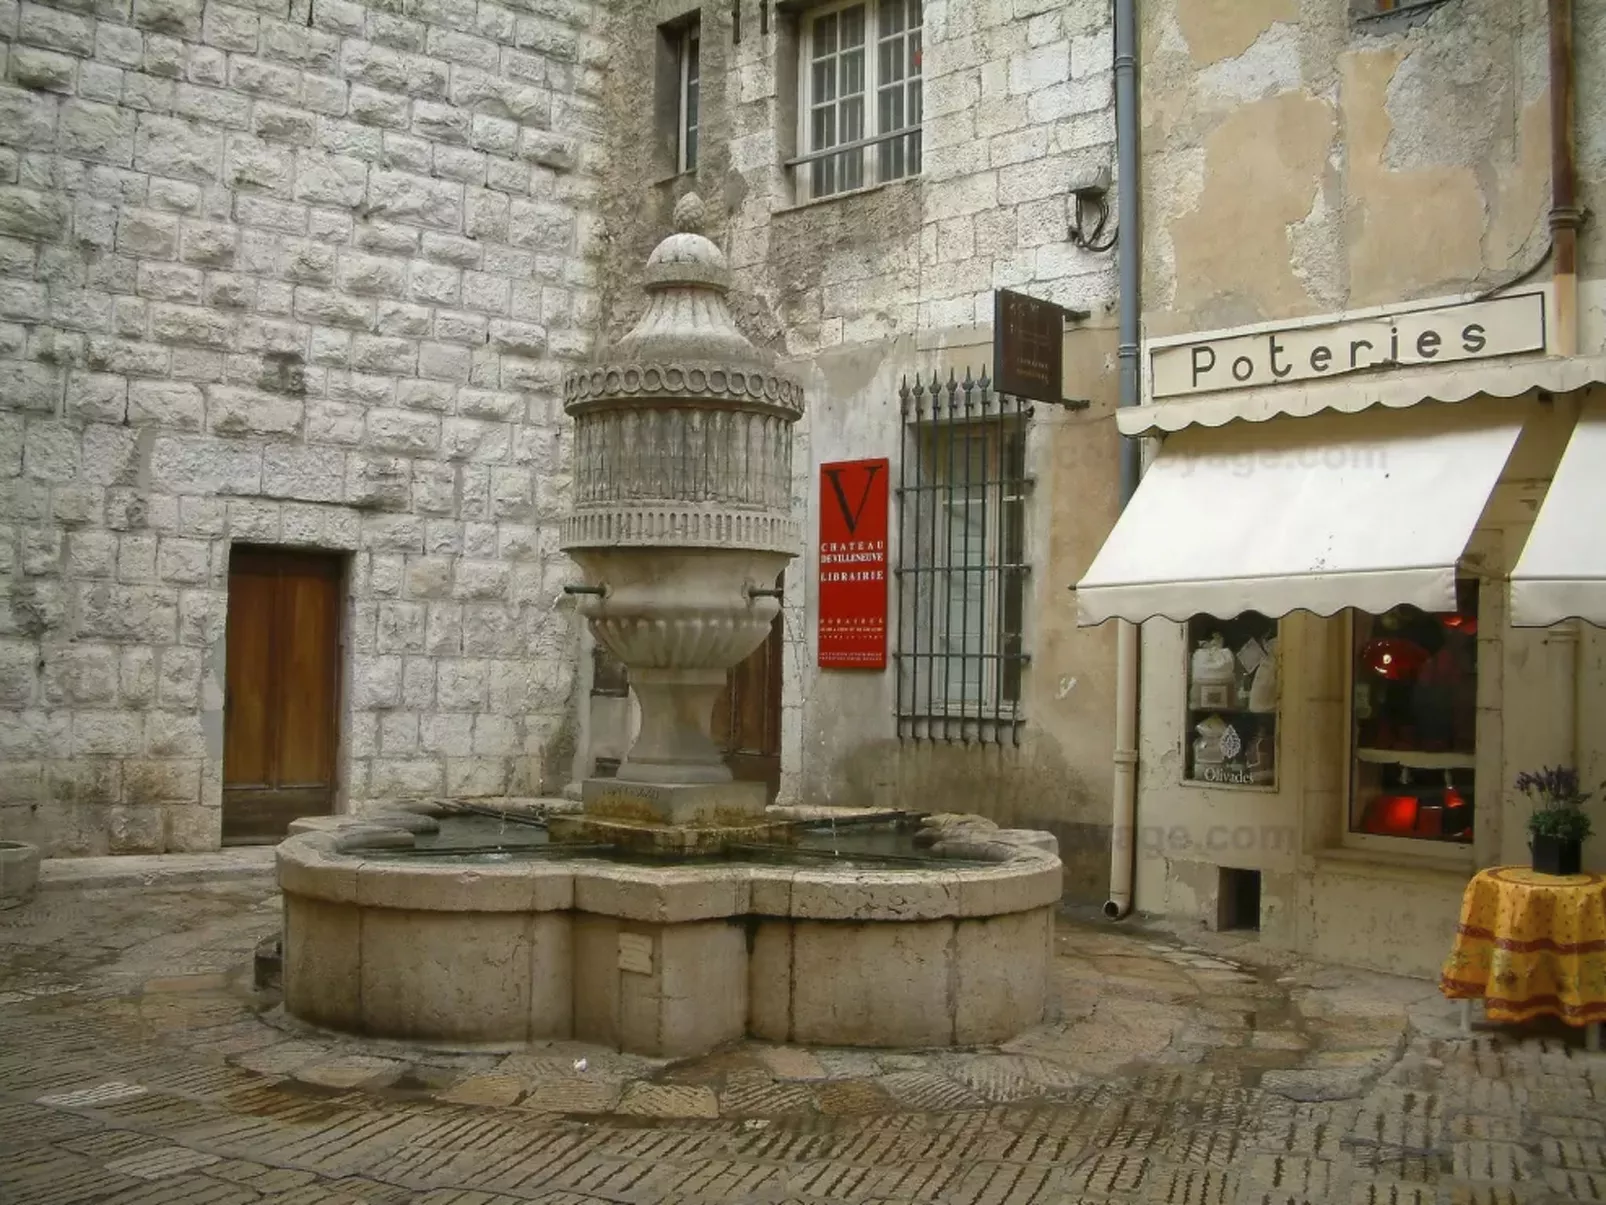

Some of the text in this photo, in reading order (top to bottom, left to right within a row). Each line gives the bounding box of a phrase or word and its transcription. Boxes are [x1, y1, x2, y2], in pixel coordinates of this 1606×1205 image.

[1190, 323, 1487, 388] Poteries
[823, 465, 883, 536] V
[820, 540, 884, 552] CHATEAU
[820, 570, 884, 582] LIBRAIRIE
[1203, 766, 1255, 784] Olivades
